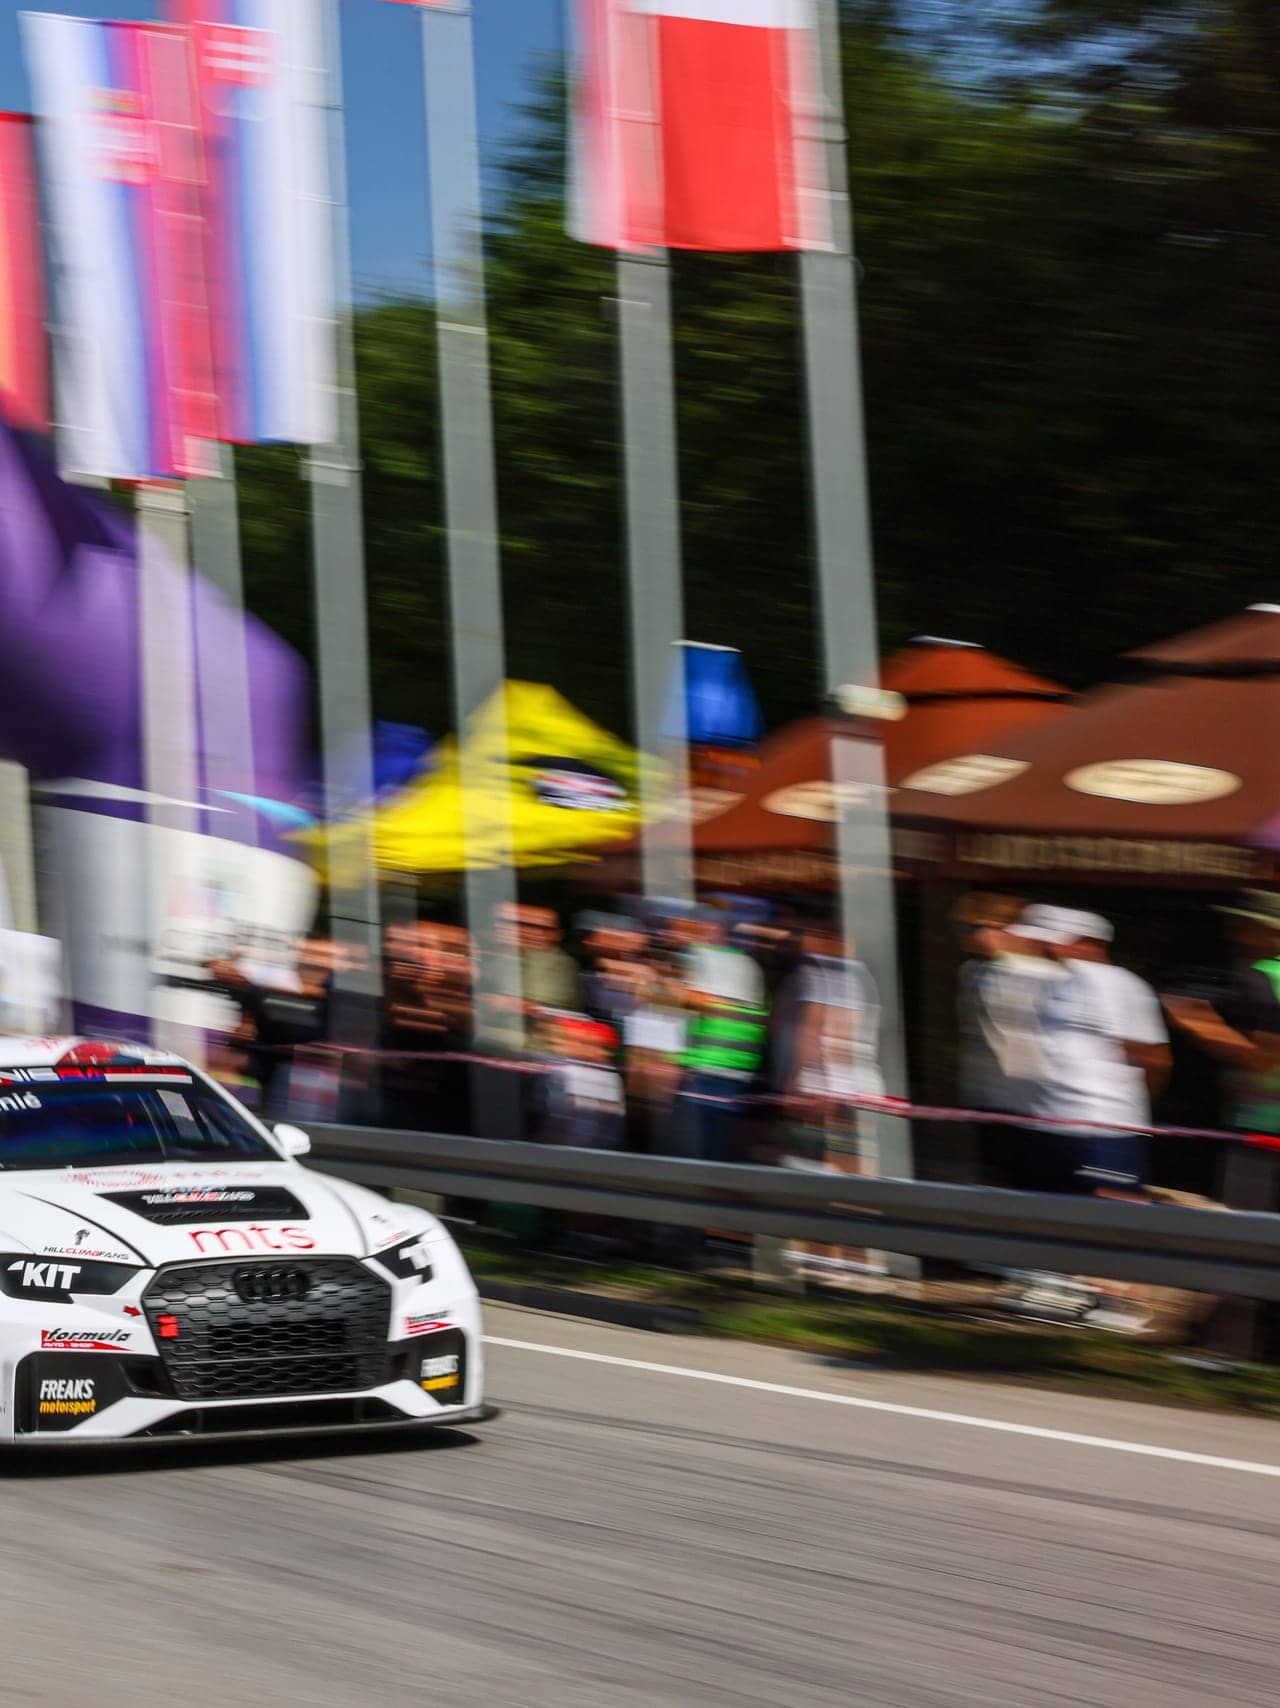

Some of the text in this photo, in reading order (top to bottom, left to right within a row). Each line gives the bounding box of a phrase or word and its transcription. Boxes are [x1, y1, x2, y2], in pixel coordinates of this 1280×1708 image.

[188, 1223, 318, 1253] mts
[47, 1328, 134, 1342] formula
[40, 1378, 95, 1400] FREAKS
[39, 1398, 97, 1416] motorsport
